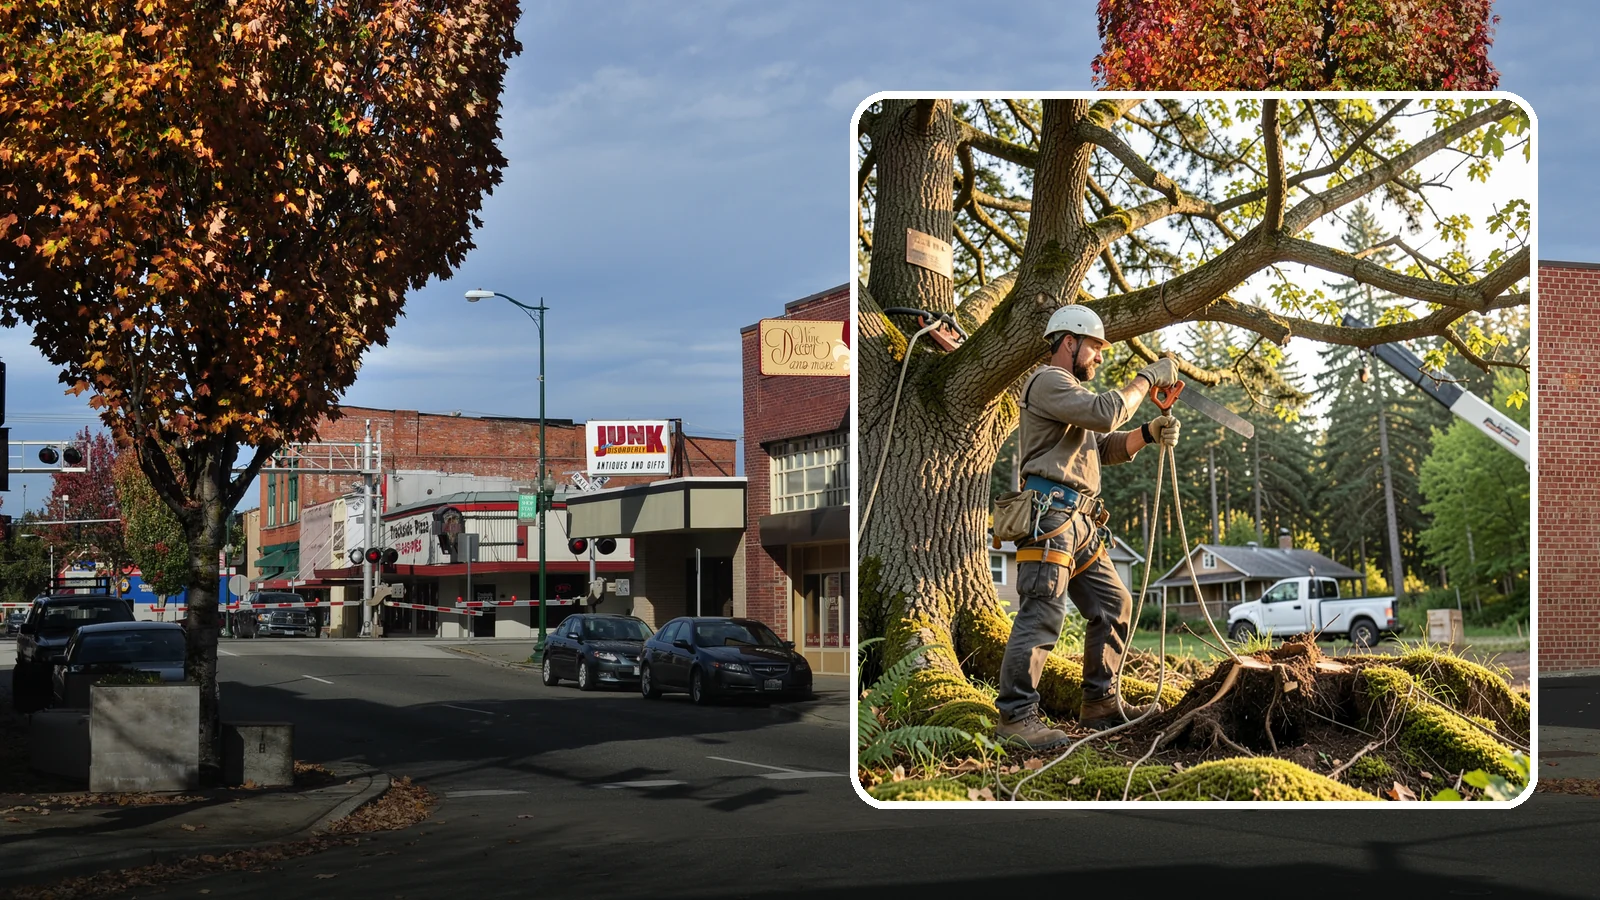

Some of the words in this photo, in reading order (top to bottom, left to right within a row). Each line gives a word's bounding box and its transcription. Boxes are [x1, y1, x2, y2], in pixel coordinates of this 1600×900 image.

[595, 425, 665, 457] JUNK
[597, 461, 628, 470] ANTIQUES
[631, 461, 644, 470] AND
[647, 460, 665, 469] GIFTS
[390, 522, 413, 540] Trackside
[415, 520, 429, 535] Pizza
